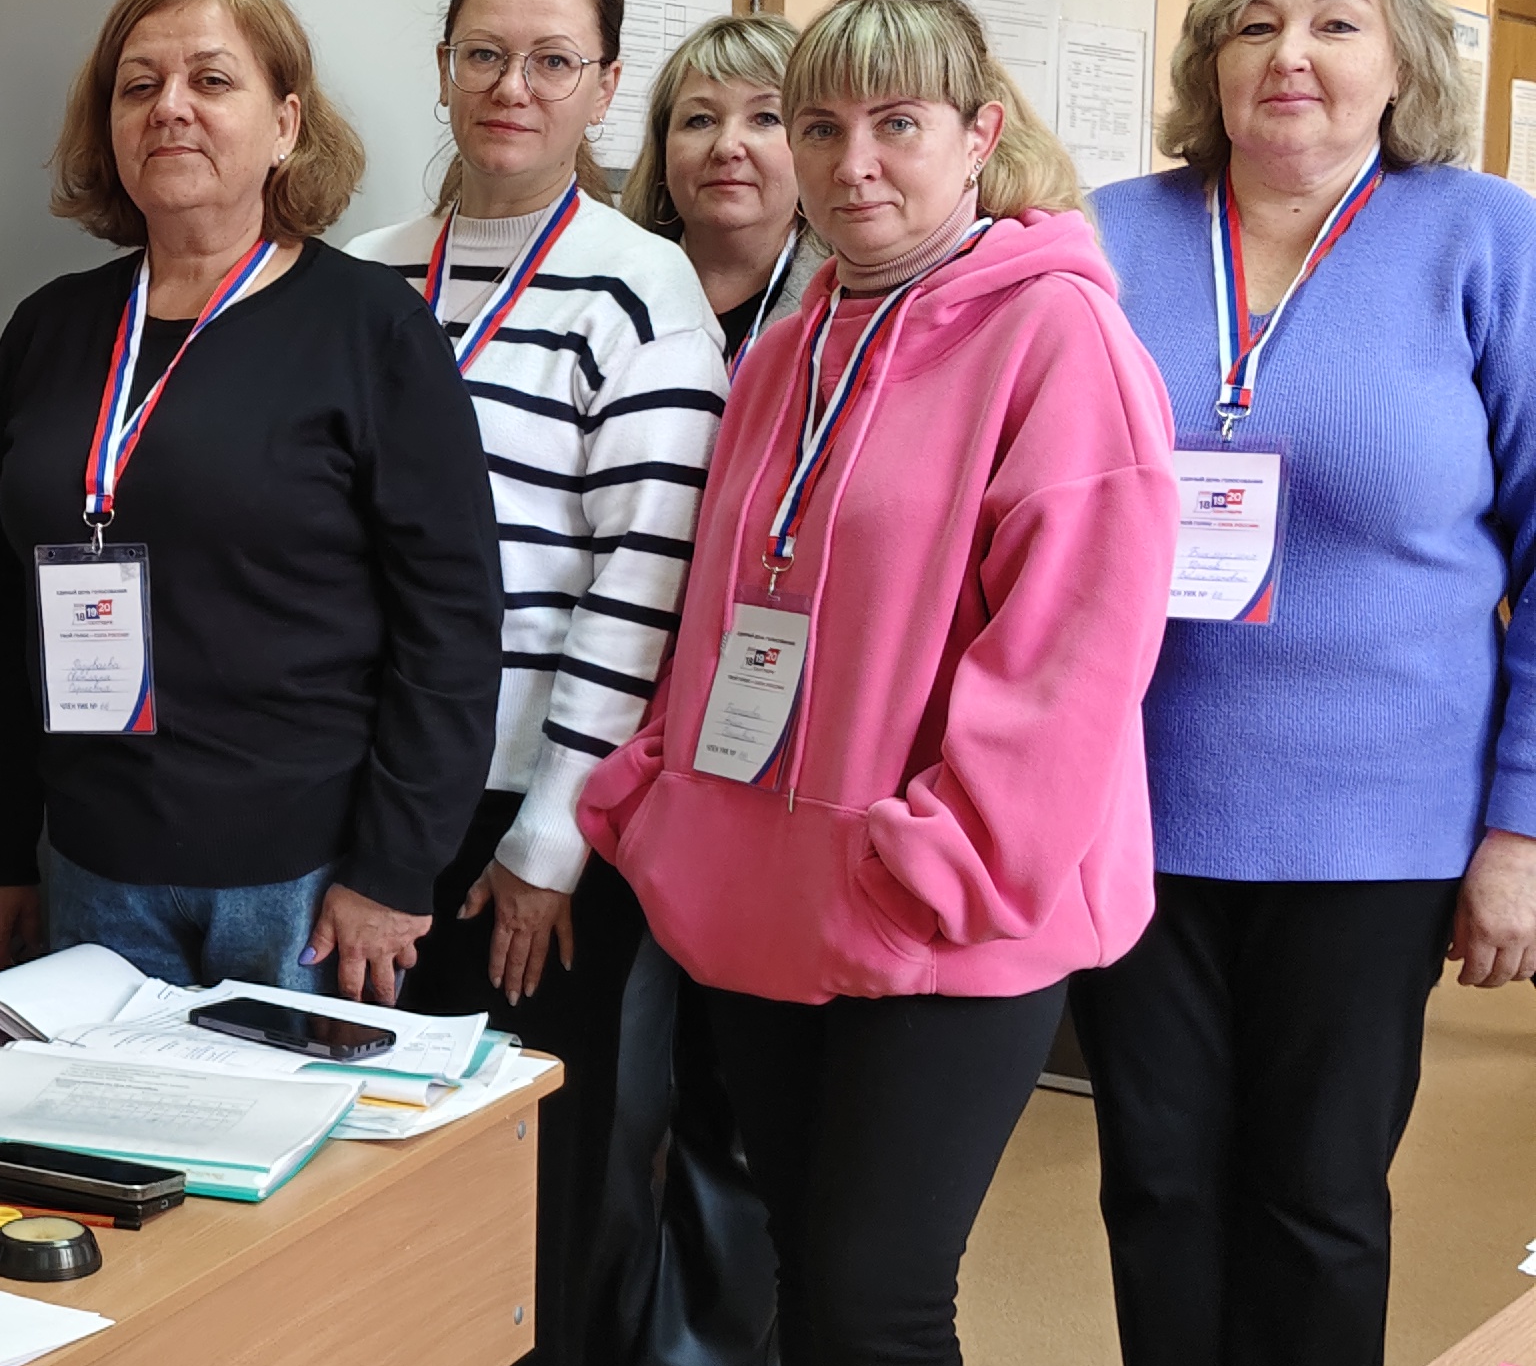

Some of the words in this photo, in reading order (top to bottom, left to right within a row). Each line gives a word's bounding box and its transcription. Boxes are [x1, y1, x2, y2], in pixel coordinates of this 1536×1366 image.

[1213, 496, 1224, 505] 19
[1226, 493, 1241, 502] 20
[98, 602, 111, 612] 20
